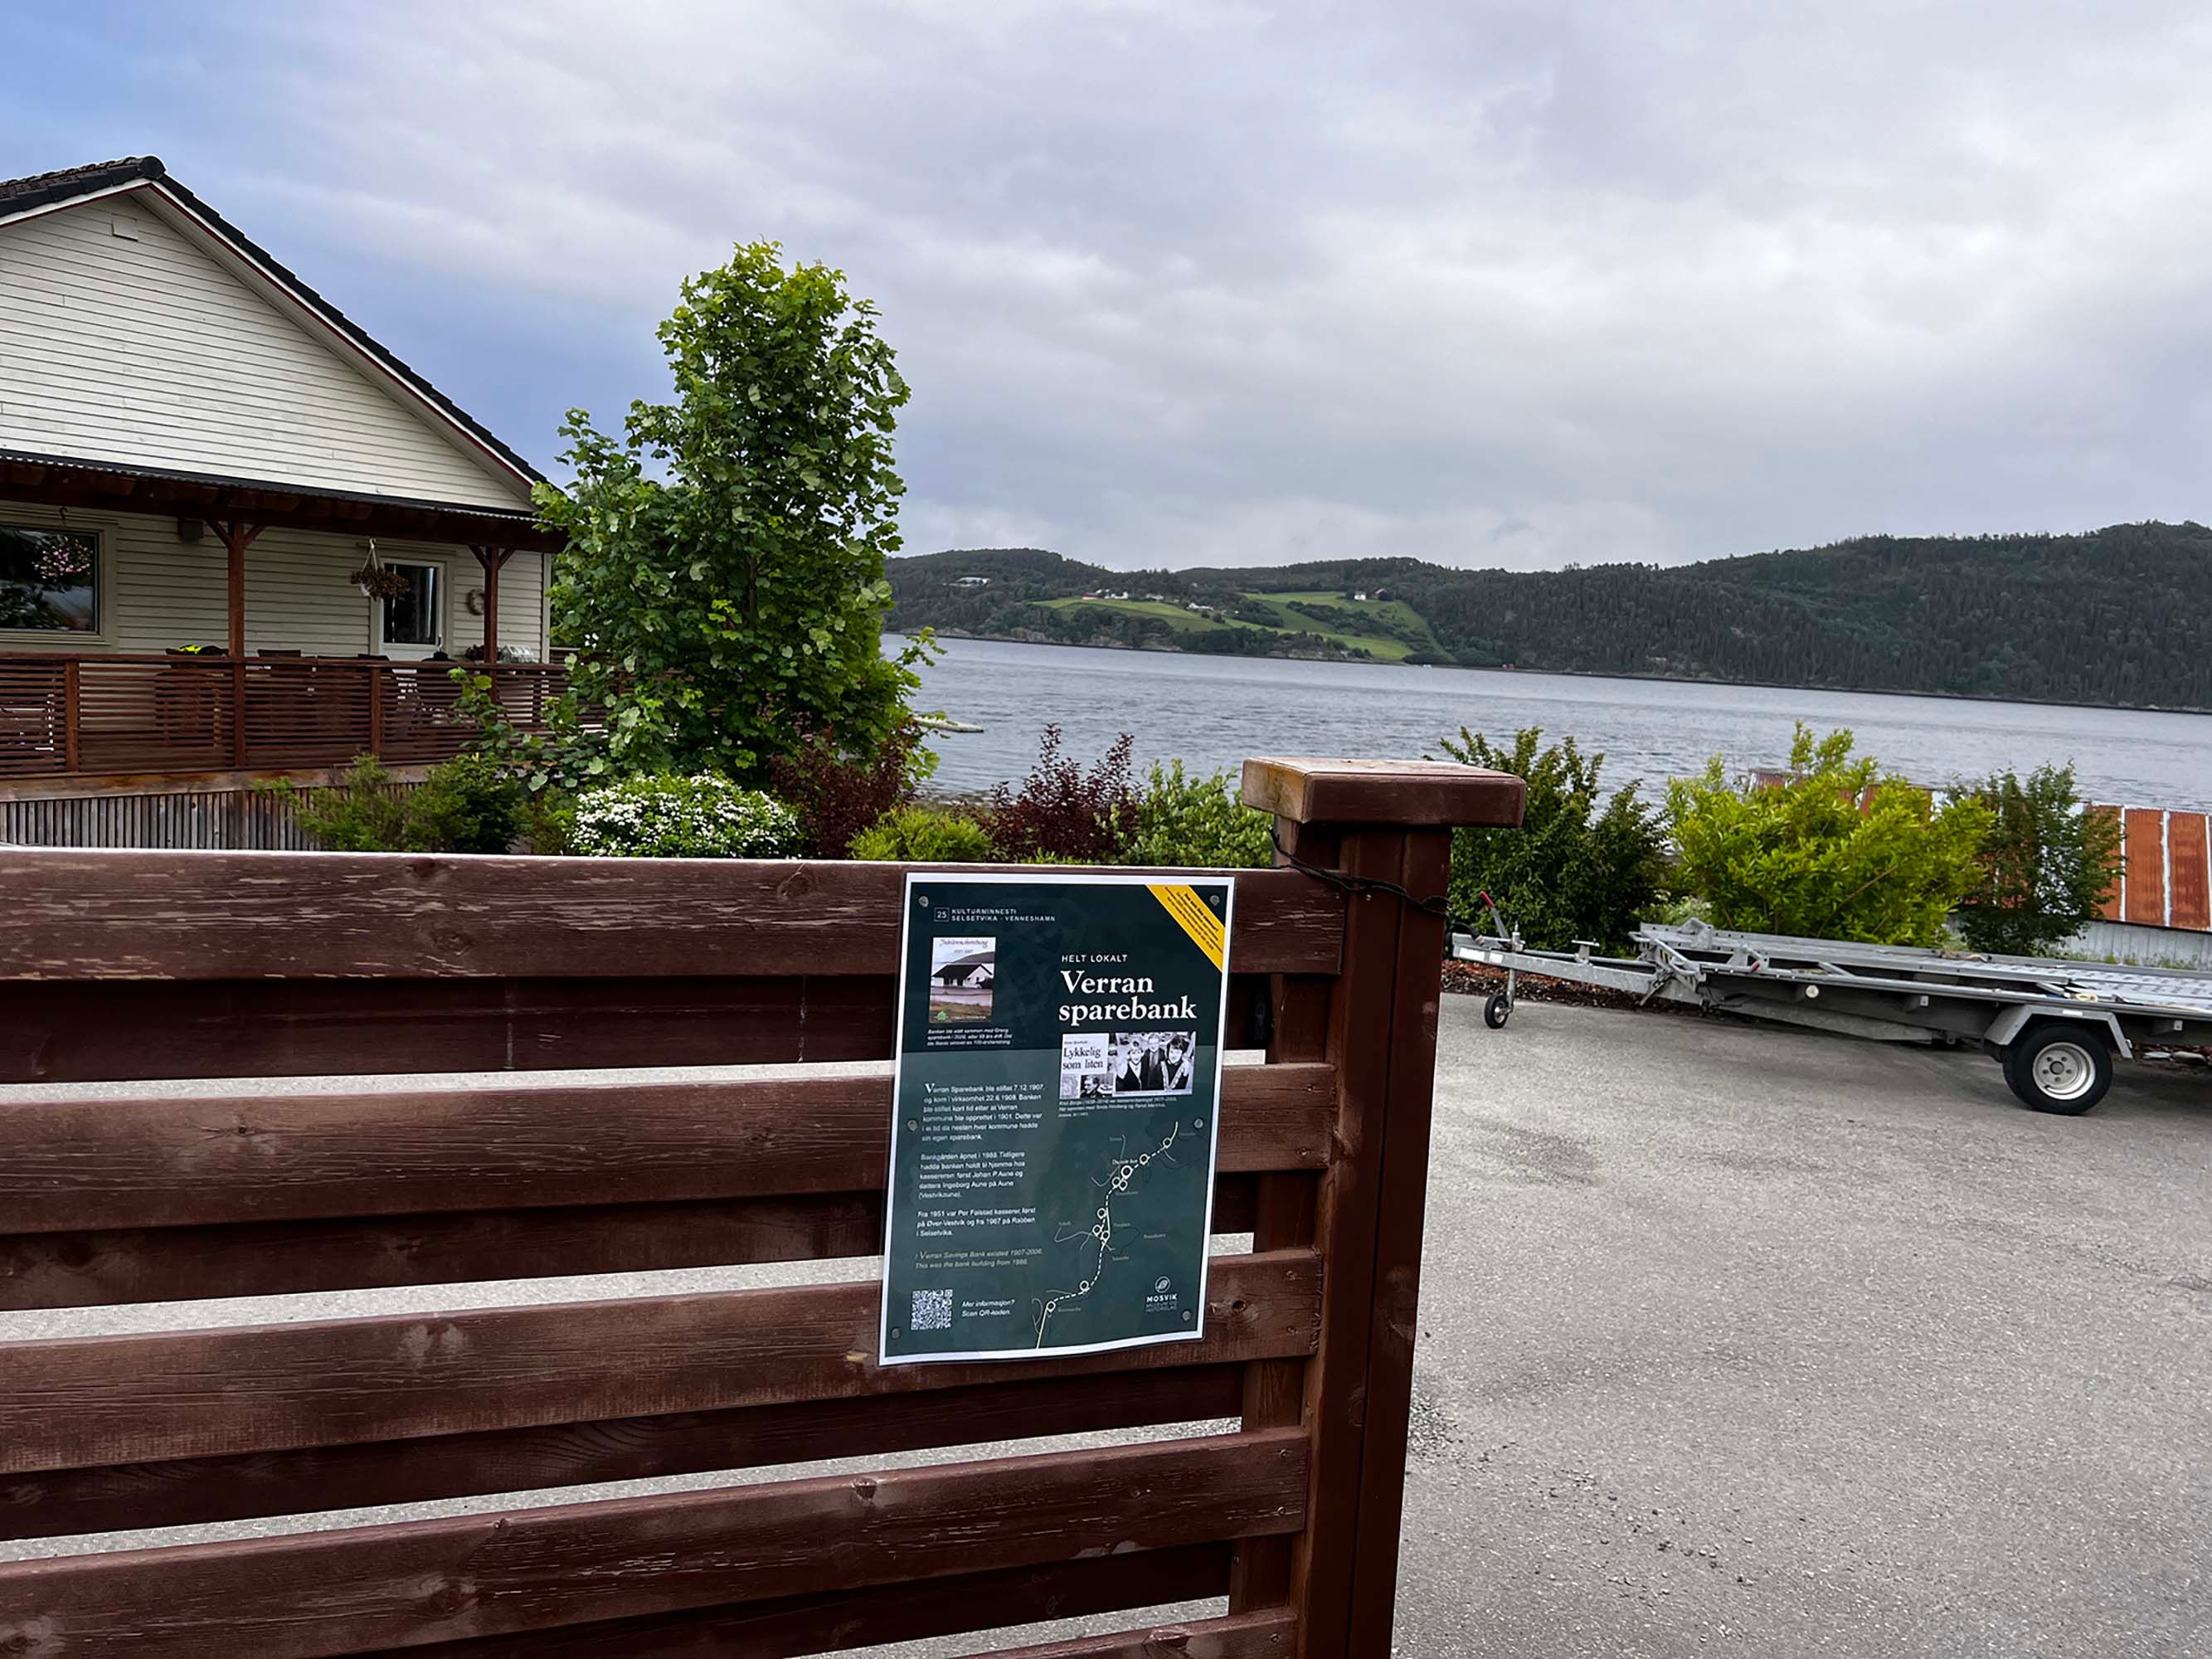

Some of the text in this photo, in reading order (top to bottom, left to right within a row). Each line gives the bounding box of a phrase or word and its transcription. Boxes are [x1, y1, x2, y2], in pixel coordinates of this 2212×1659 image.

[1091, 954, 1128, 962] LOKALT
[1060, 970, 1154, 994] Verran
[1058, 995, 1197, 1026] sparebank
[1063, 1047, 1101, 1059] Lykkelig
[1085, 1060, 1103, 1068] liten
[925, 1082, 950, 1094] Verran
[950, 1085, 984, 1093] Sparebank
[1146, 1294, 1178, 1302] MOSVIK
